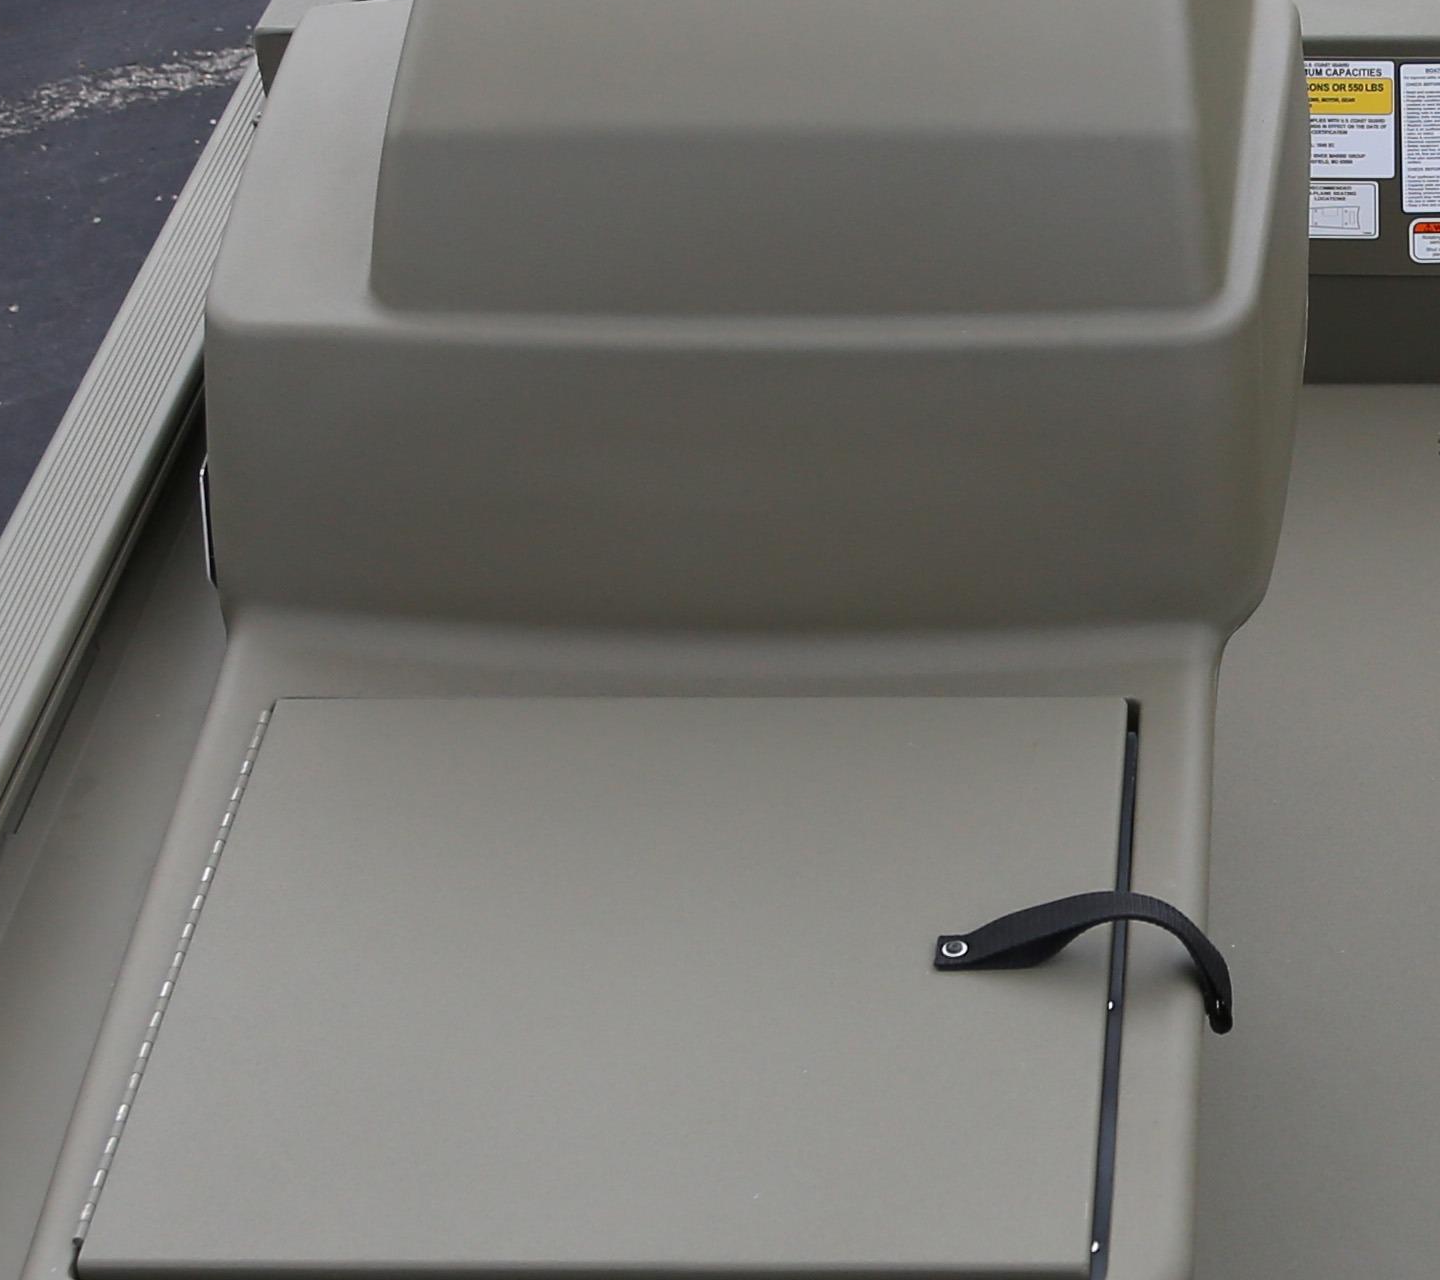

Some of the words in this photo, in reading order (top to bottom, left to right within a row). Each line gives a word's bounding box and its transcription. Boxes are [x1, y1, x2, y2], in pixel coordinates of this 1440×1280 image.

[1308, 84, 1329, 92] ONS
[1332, 84, 1345, 92] OR
[1348, 84, 1364, 92] 550
[1365, 84, 1384, 92] LBS
